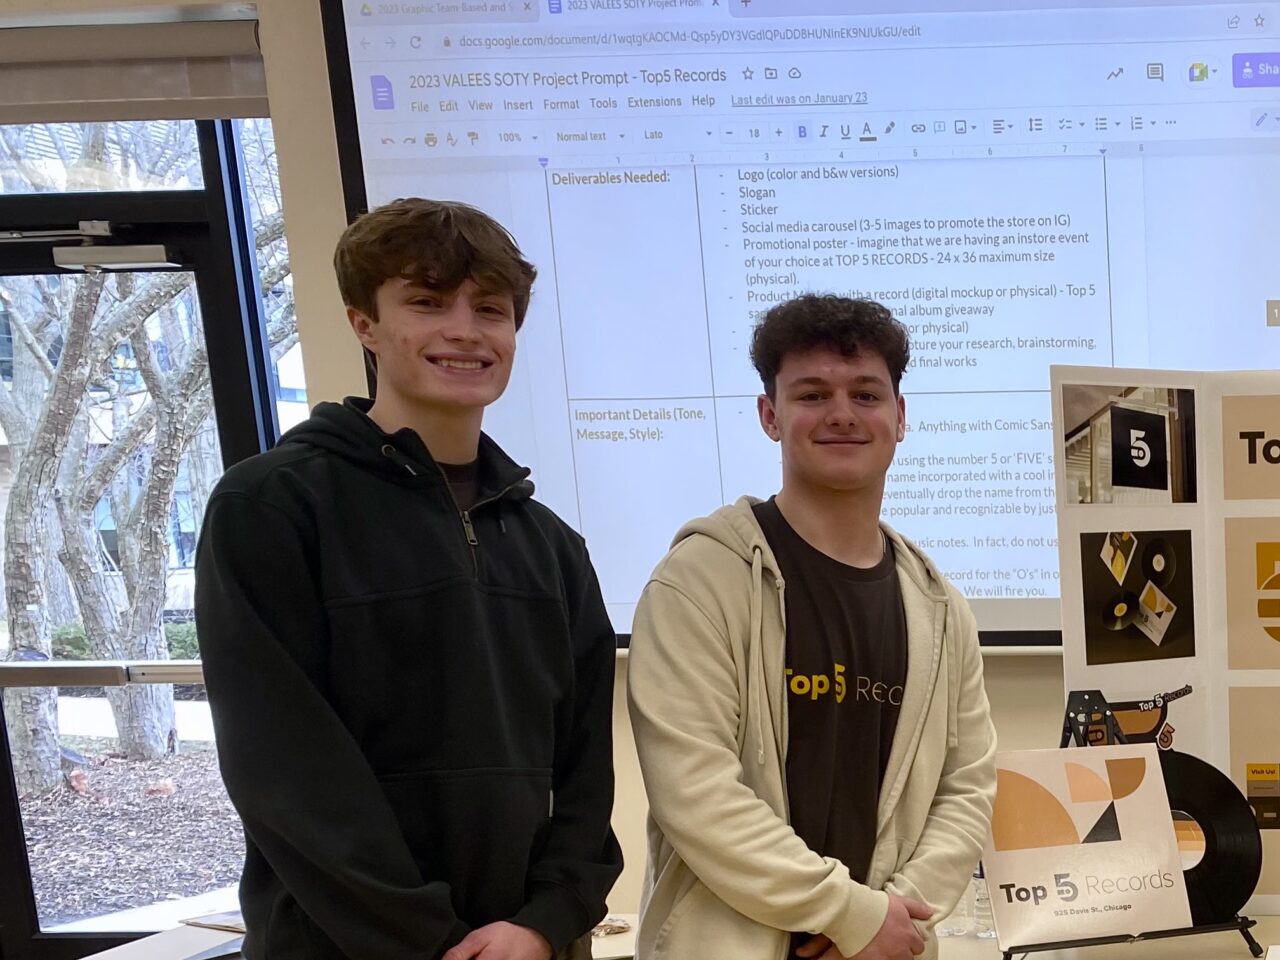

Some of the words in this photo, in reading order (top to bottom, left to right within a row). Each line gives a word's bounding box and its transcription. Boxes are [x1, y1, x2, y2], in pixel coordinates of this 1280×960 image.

[408, 74, 441, 89] 2023
[443, 73, 491, 88] VALEES
[494, 72, 529, 86] SOTY
[533, 72, 579, 90] Project
[581, 71, 629, 88] Prompt
[640, 70, 671, 86] Top5
[674, 68, 727, 83] Records
[411, 101, 429, 113] File
[439, 101, 458, 112] Edit
[468, 100, 493, 111] View
[503, 99, 534, 110] Insert
[543, 98, 580, 110] Format
[590, 97, 618, 109] Tools
[628, 97, 682, 109] Extensions
[692, 95, 715, 108] Help
[756, 93, 775, 105] edit
[813, 92, 853, 105] January
[556, 131, 589, 143] Normal
[644, 129, 663, 140] Lato
[551, 172, 622, 186] Deliverables
[624, 169, 671, 184] Needed:
[738, 168, 764, 183] Logo
[766, 167, 798, 182] (color
[800, 167, 821, 179] and
[823, 166, 848, 179] b&w
[850, 164, 899, 179] versions)
[739, 185, 776, 201] Slogan
[740, 203, 778, 216] Sticker
[742, 220, 774, 234] Social
[776, 220, 810, 233] media
[812, 219, 857, 233] carousel
[884, 218, 921, 233] images
[937, 216, 984, 231] promote
[986, 215, 1005, 228] the
[1007, 215, 1035, 228] store
[1053, 213, 1071, 228] IG)
[743, 237, 811, 251] Promotional
[813, 239, 848, 252] poster
[857, 236, 899, 251] imagine
[901, 235, 923, 248] that
[944, 237, 962, 247] are
[963, 233, 1000, 248] having
[1017, 232, 1056, 245] instore
[1058, 232, 1089, 244] event
[758, 258, 781, 270] your
[785, 255, 820, 268] choice
[835, 253, 860, 267] TOP
[872, 251, 928, 266] RECORDS
[979, 250, 1032, 263] maximum
[1034, 249, 1055, 262] size
[746, 272, 800, 288] (physical).
[747, 289, 790, 303] Product
[874, 287, 909, 300] record
[911, 286, 949, 302] (digital
[951, 285, 994, 299] mockup
[1009, 284, 1057, 300] physical)
[1066, 283, 1087, 299] Top
[909, 303, 943, 317] album
[944, 303, 995, 319] giveaway
[922, 320, 969, 335] physical)
[939, 341, 964, 353] your
[966, 337, 1016, 350] research,
[918, 355, 942, 368] final
[944, 355, 977, 368] works
[574, 408, 632, 424] Important
[633, 407, 672, 421] Details
[674, 407, 706, 422] (Tone,
[918, 420, 967, 434] Anything
[968, 419, 993, 432] with
[994, 418, 1029, 431] Comic
[576, 428, 628, 442] Message,
[629, 427, 664, 442] Style):
[1130, 429, 1151, 468] 5
[897, 455, 926, 469] using
[928, 454, 945, 466] the
[947, 453, 988, 466] number
[918, 470, 987, 485] incorporated
[989, 469, 1013, 482] with
[1023, 468, 1046, 481] cool
[937, 486, 963, 501] drop
[964, 486, 983, 499] the
[984, 487, 1013, 499] name
[1015, 485, 1042, 498] from
[890, 504, 930, 519] popular
[932, 503, 951, 516] and
[954, 503, 1022, 517] recognizable
[937, 536, 969, 549] notes.
[1027, 536, 1046, 547] not
[993, 568, 1011, 580] the
[963, 585, 983, 597] We
[985, 584, 1004, 596] will
[1005, 584, 1024, 596] fire
[784, 668, 830, 701] op
[834, 663, 847, 704] 5
[1138, 701, 1154, 711] Top
[1154, 693, 1164, 707] 5
[999, 882, 1048, 906] Top
[1053, 872, 1079, 902] 5
[1085, 868, 1175, 897] Records
[1053, 908, 1069, 918] 925
[1070, 906, 1090, 916] Davis
[1103, 903, 1132, 913] Chicago
